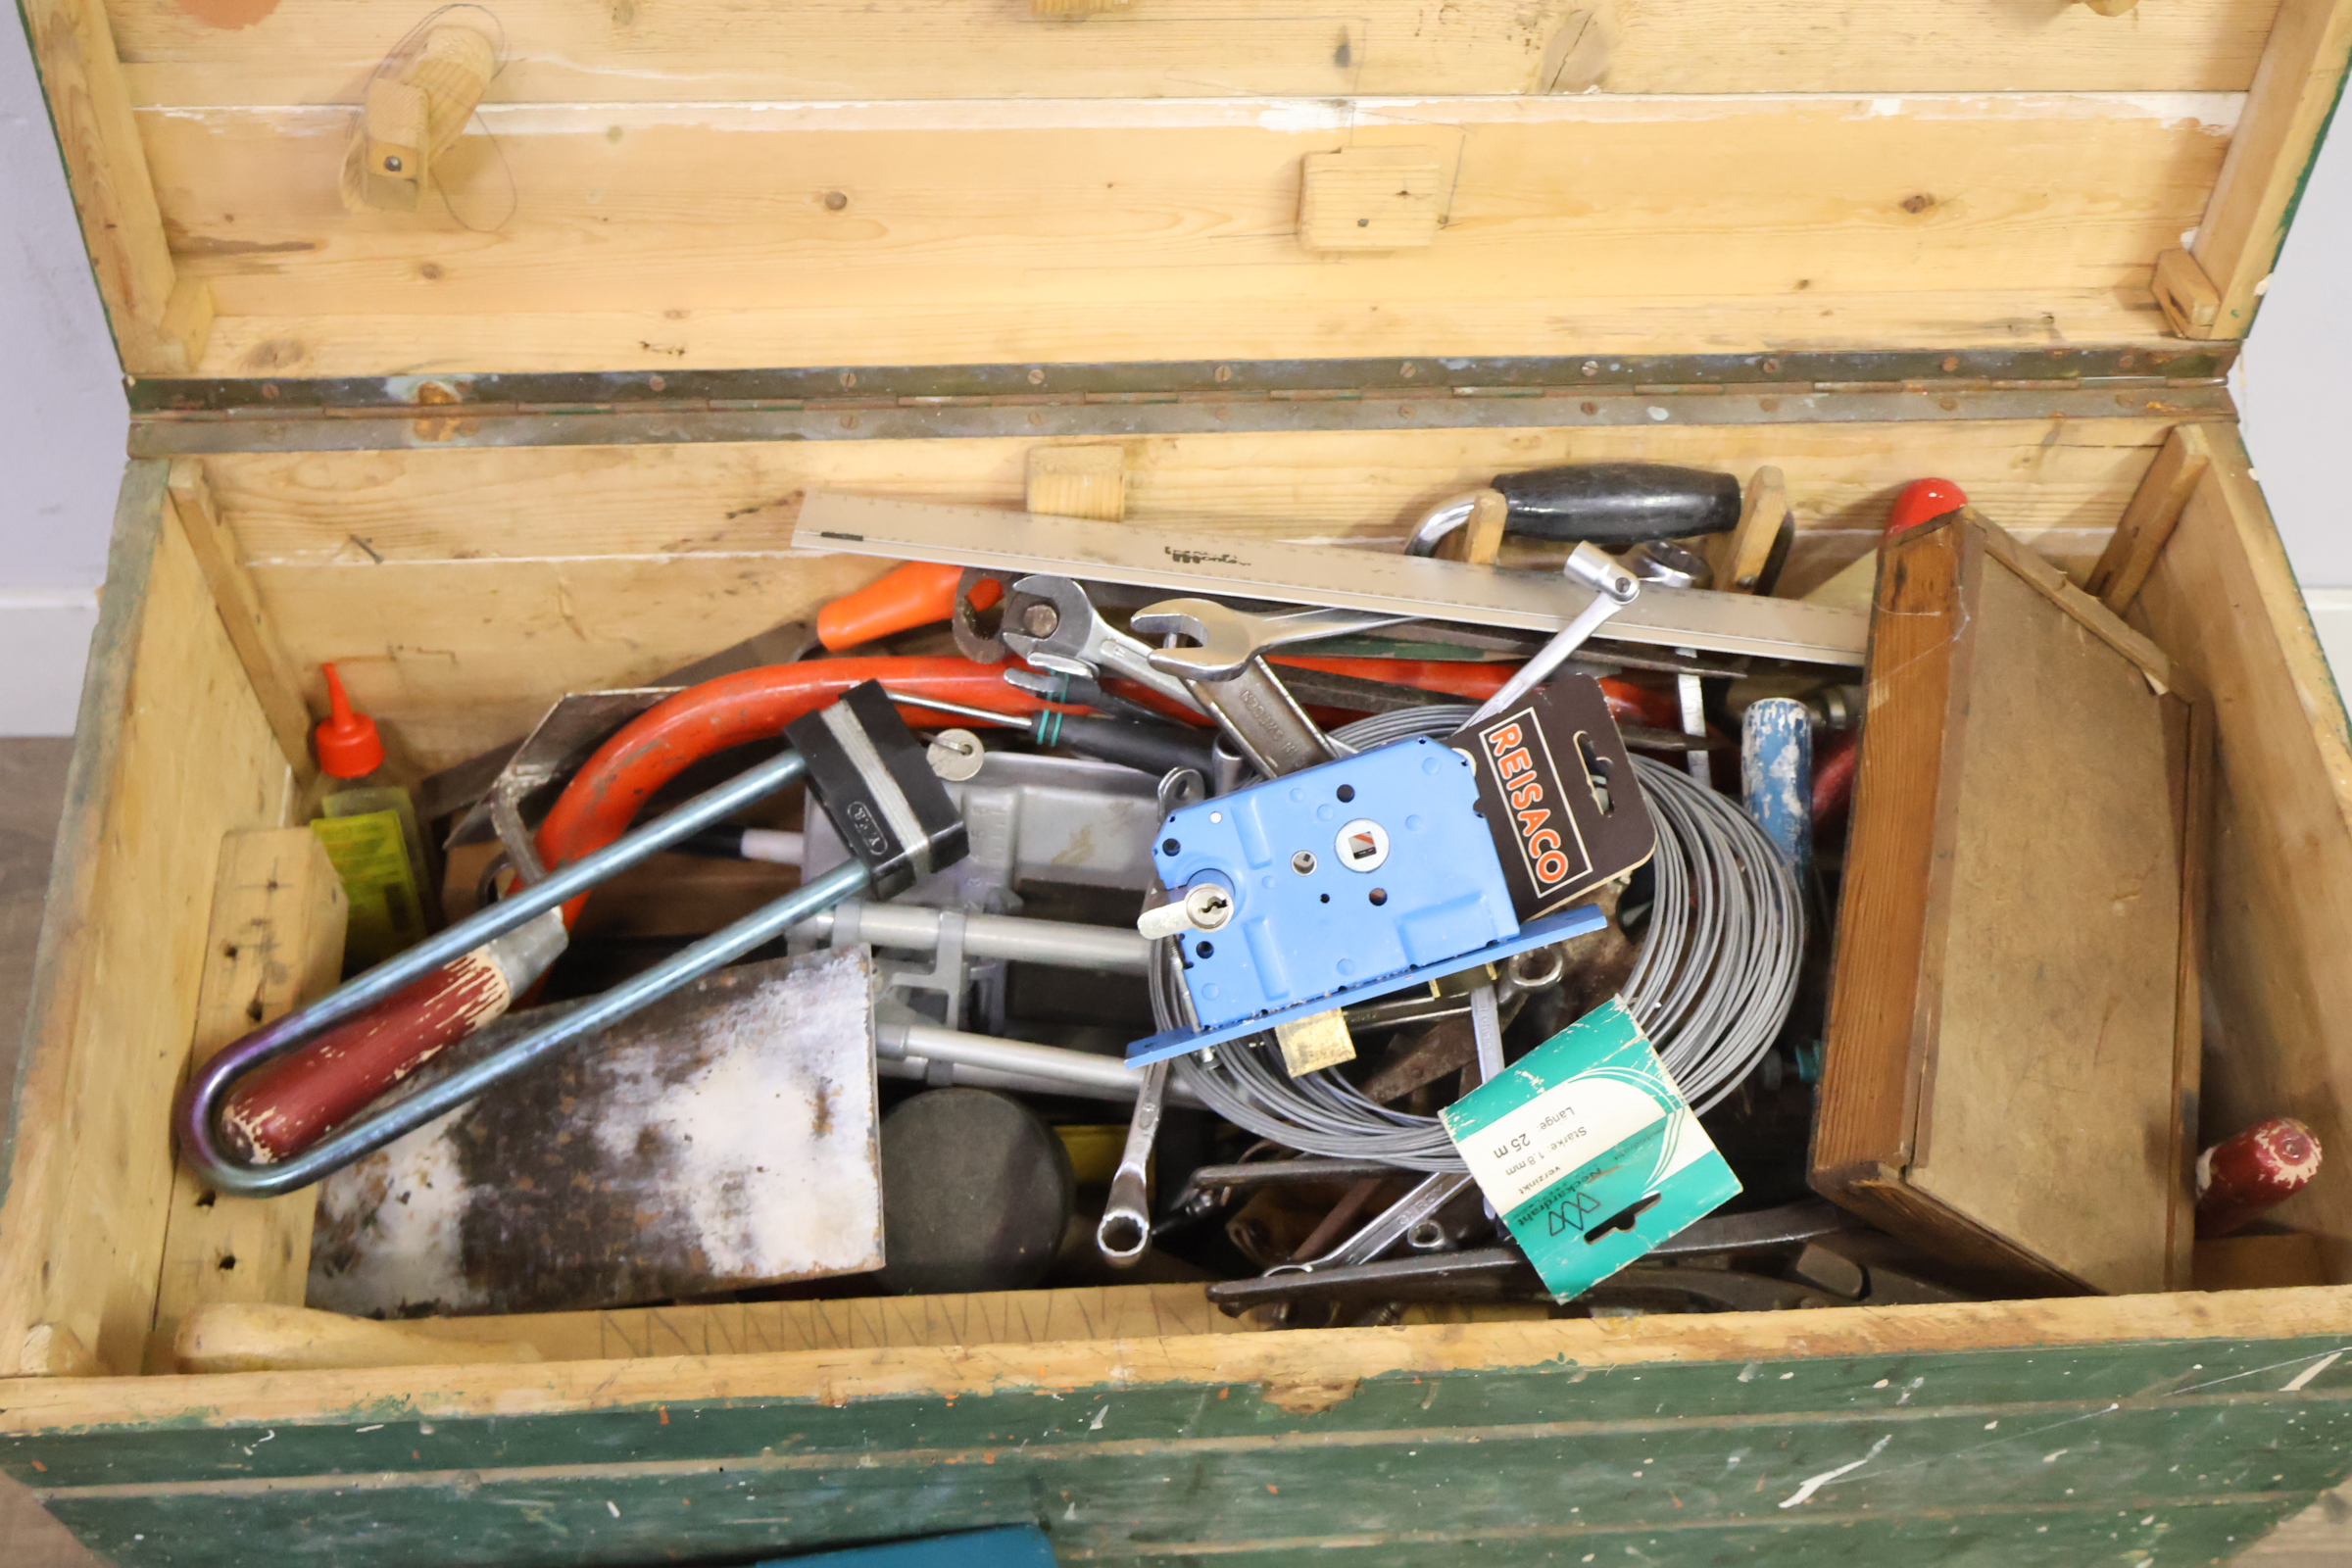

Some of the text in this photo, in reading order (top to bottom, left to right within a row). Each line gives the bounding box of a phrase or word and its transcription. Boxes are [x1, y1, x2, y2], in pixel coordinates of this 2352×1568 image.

[1489, 723, 1569, 884] REISACO
[1493, 1145, 1509, 1159] m
[1510, 1133, 1531, 1152] 25
[1504, 1160, 1527, 1176] mm
[1518, 1166, 1561, 1195] verzinkt
[1517, 1167, 1602, 1226] Neckardraht
